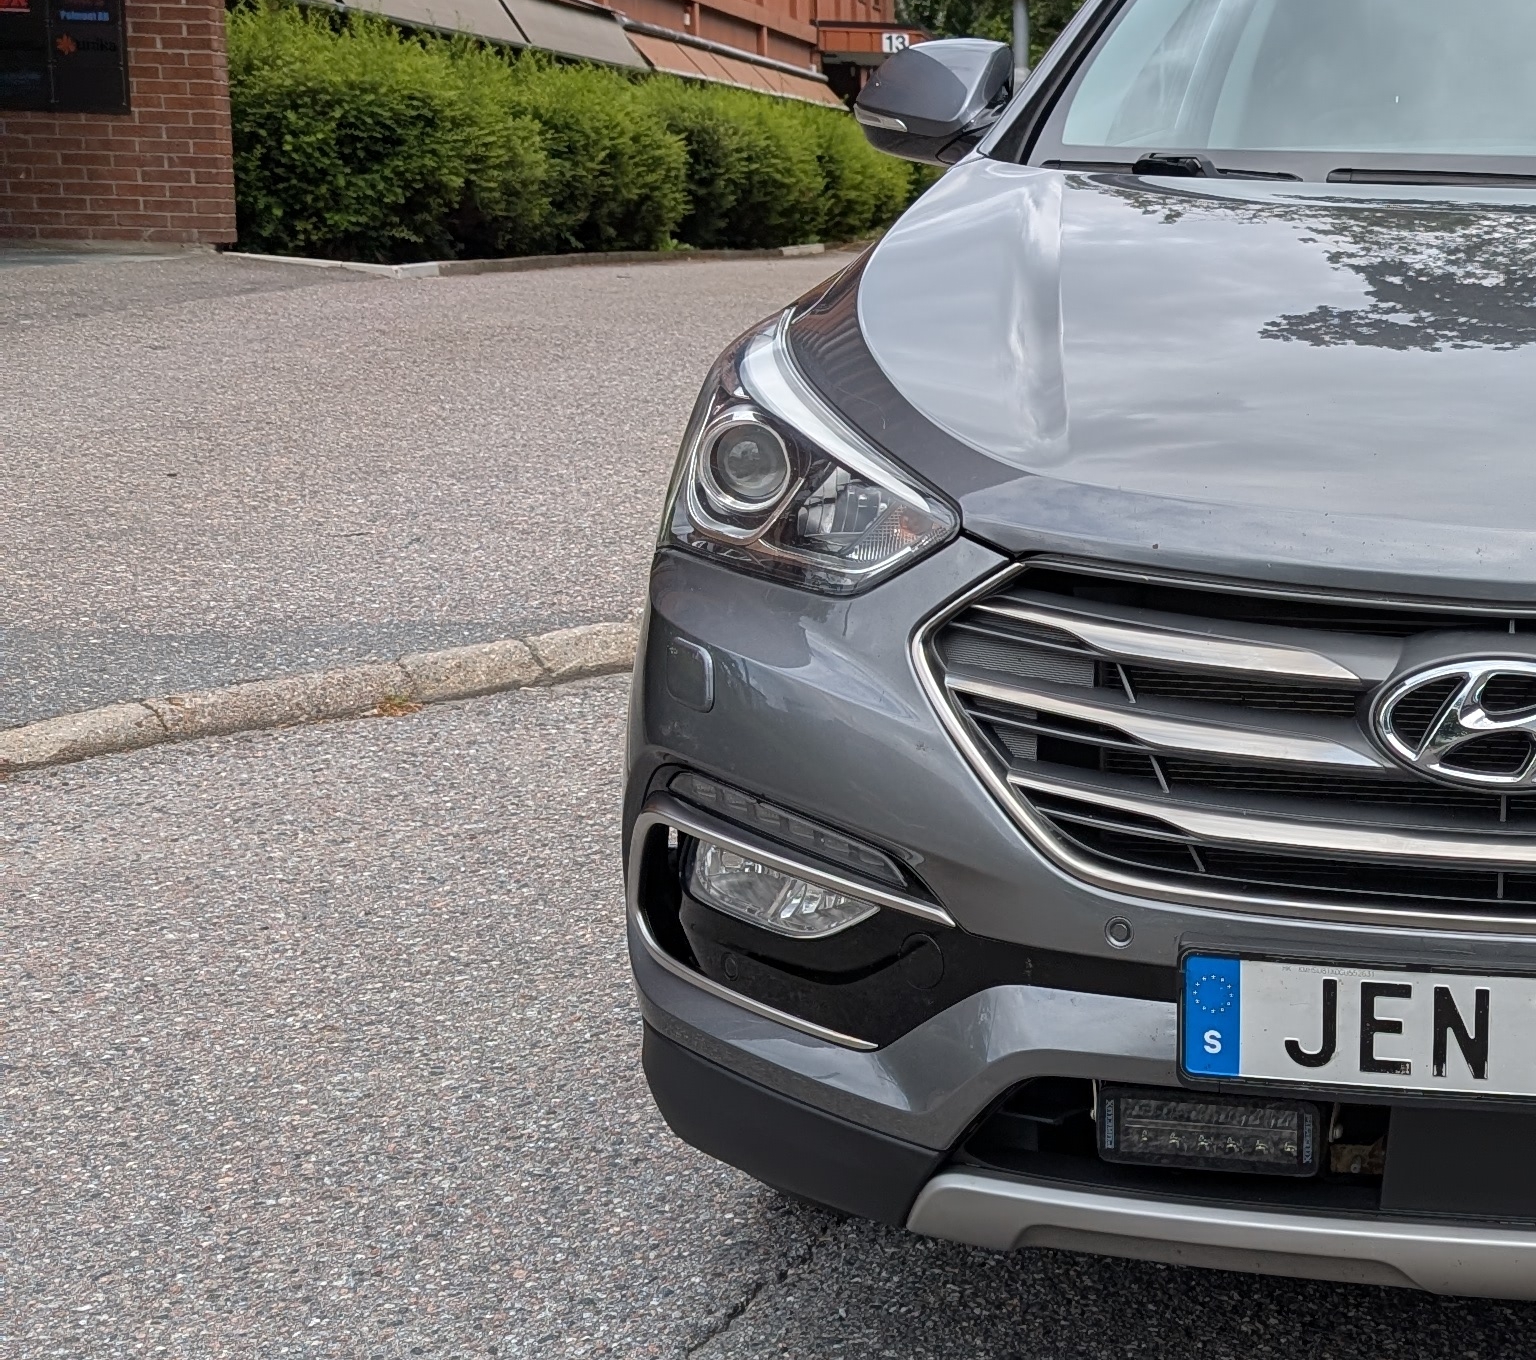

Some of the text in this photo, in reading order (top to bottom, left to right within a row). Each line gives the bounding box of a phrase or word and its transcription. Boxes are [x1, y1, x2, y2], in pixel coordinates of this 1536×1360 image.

[885, 35, 905, 52] 13
[1203, 1029, 1222, 1055] S
[1284, 977, 1491, 1081] JEN
